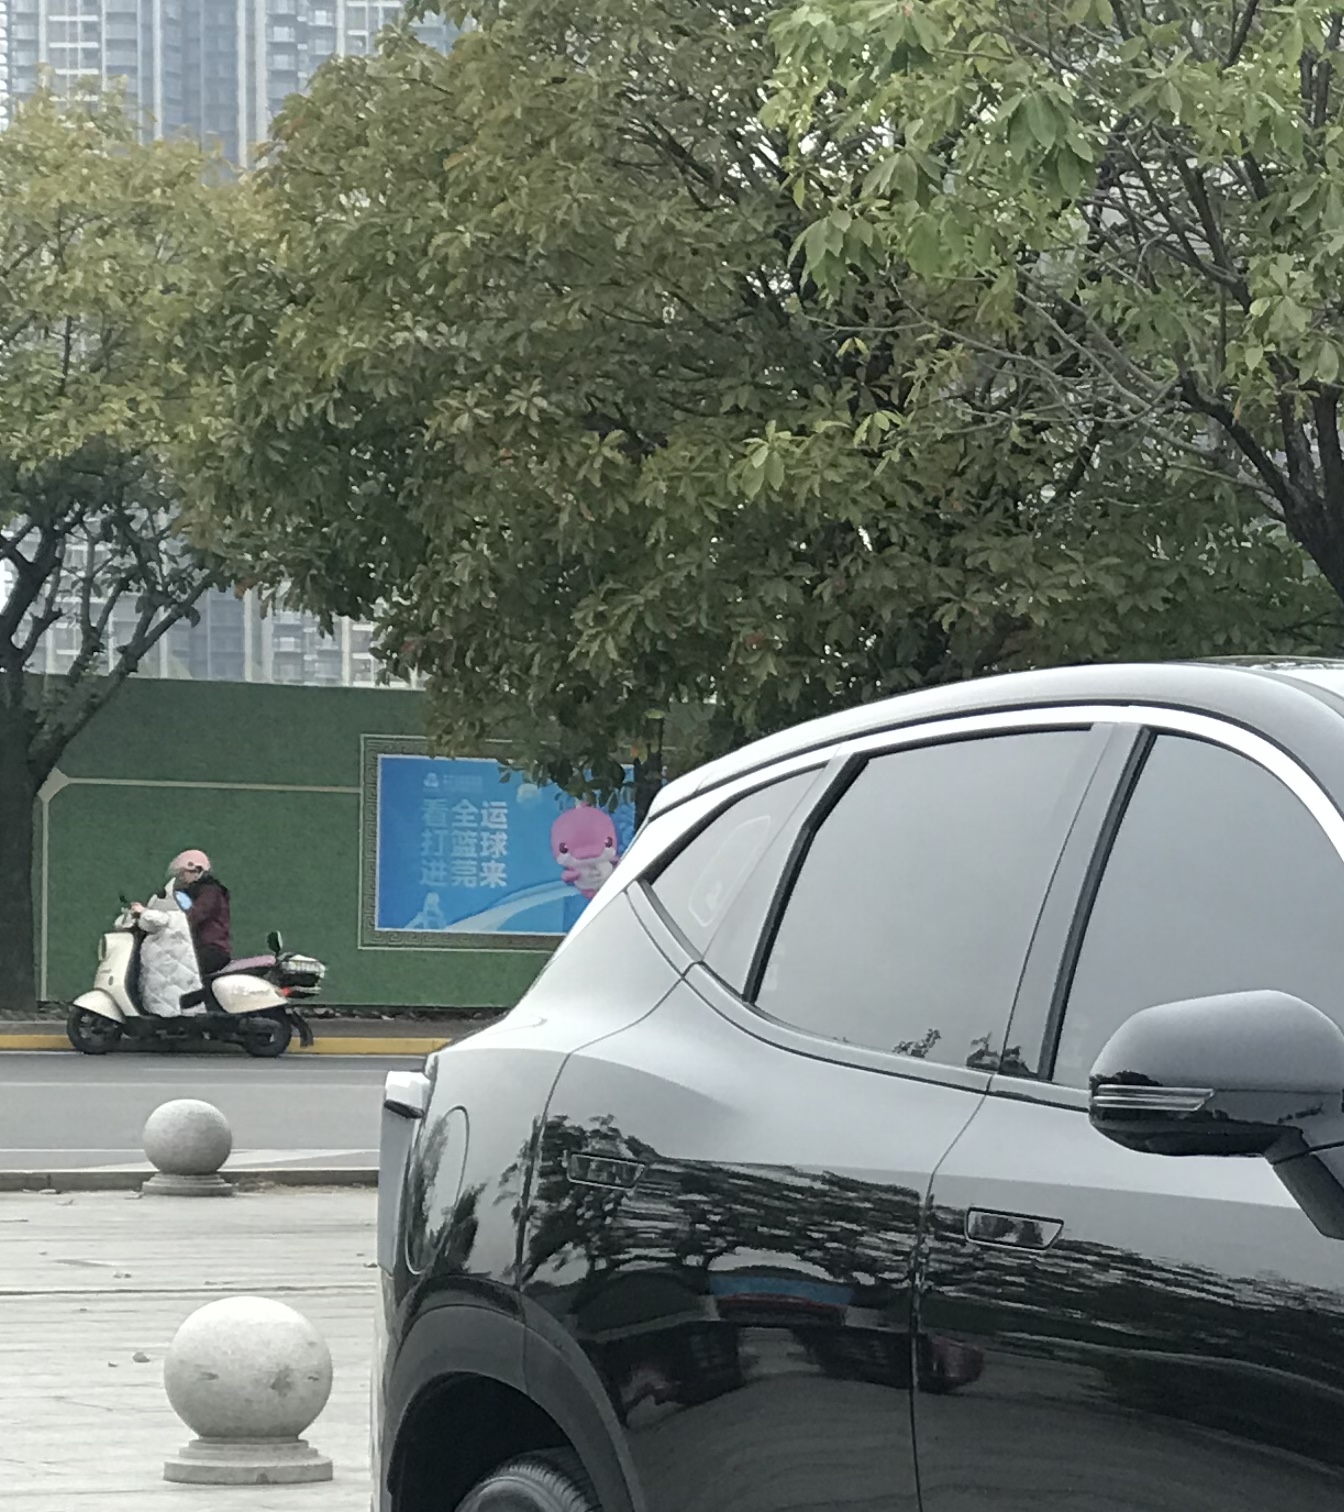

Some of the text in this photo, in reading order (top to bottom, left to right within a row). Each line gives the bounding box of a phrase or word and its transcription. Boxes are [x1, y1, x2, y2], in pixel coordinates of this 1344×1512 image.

[421, 798, 508, 829] 看全运
[420, 829, 508, 859] 打篮球
[419, 859, 508, 888] 进莞来
